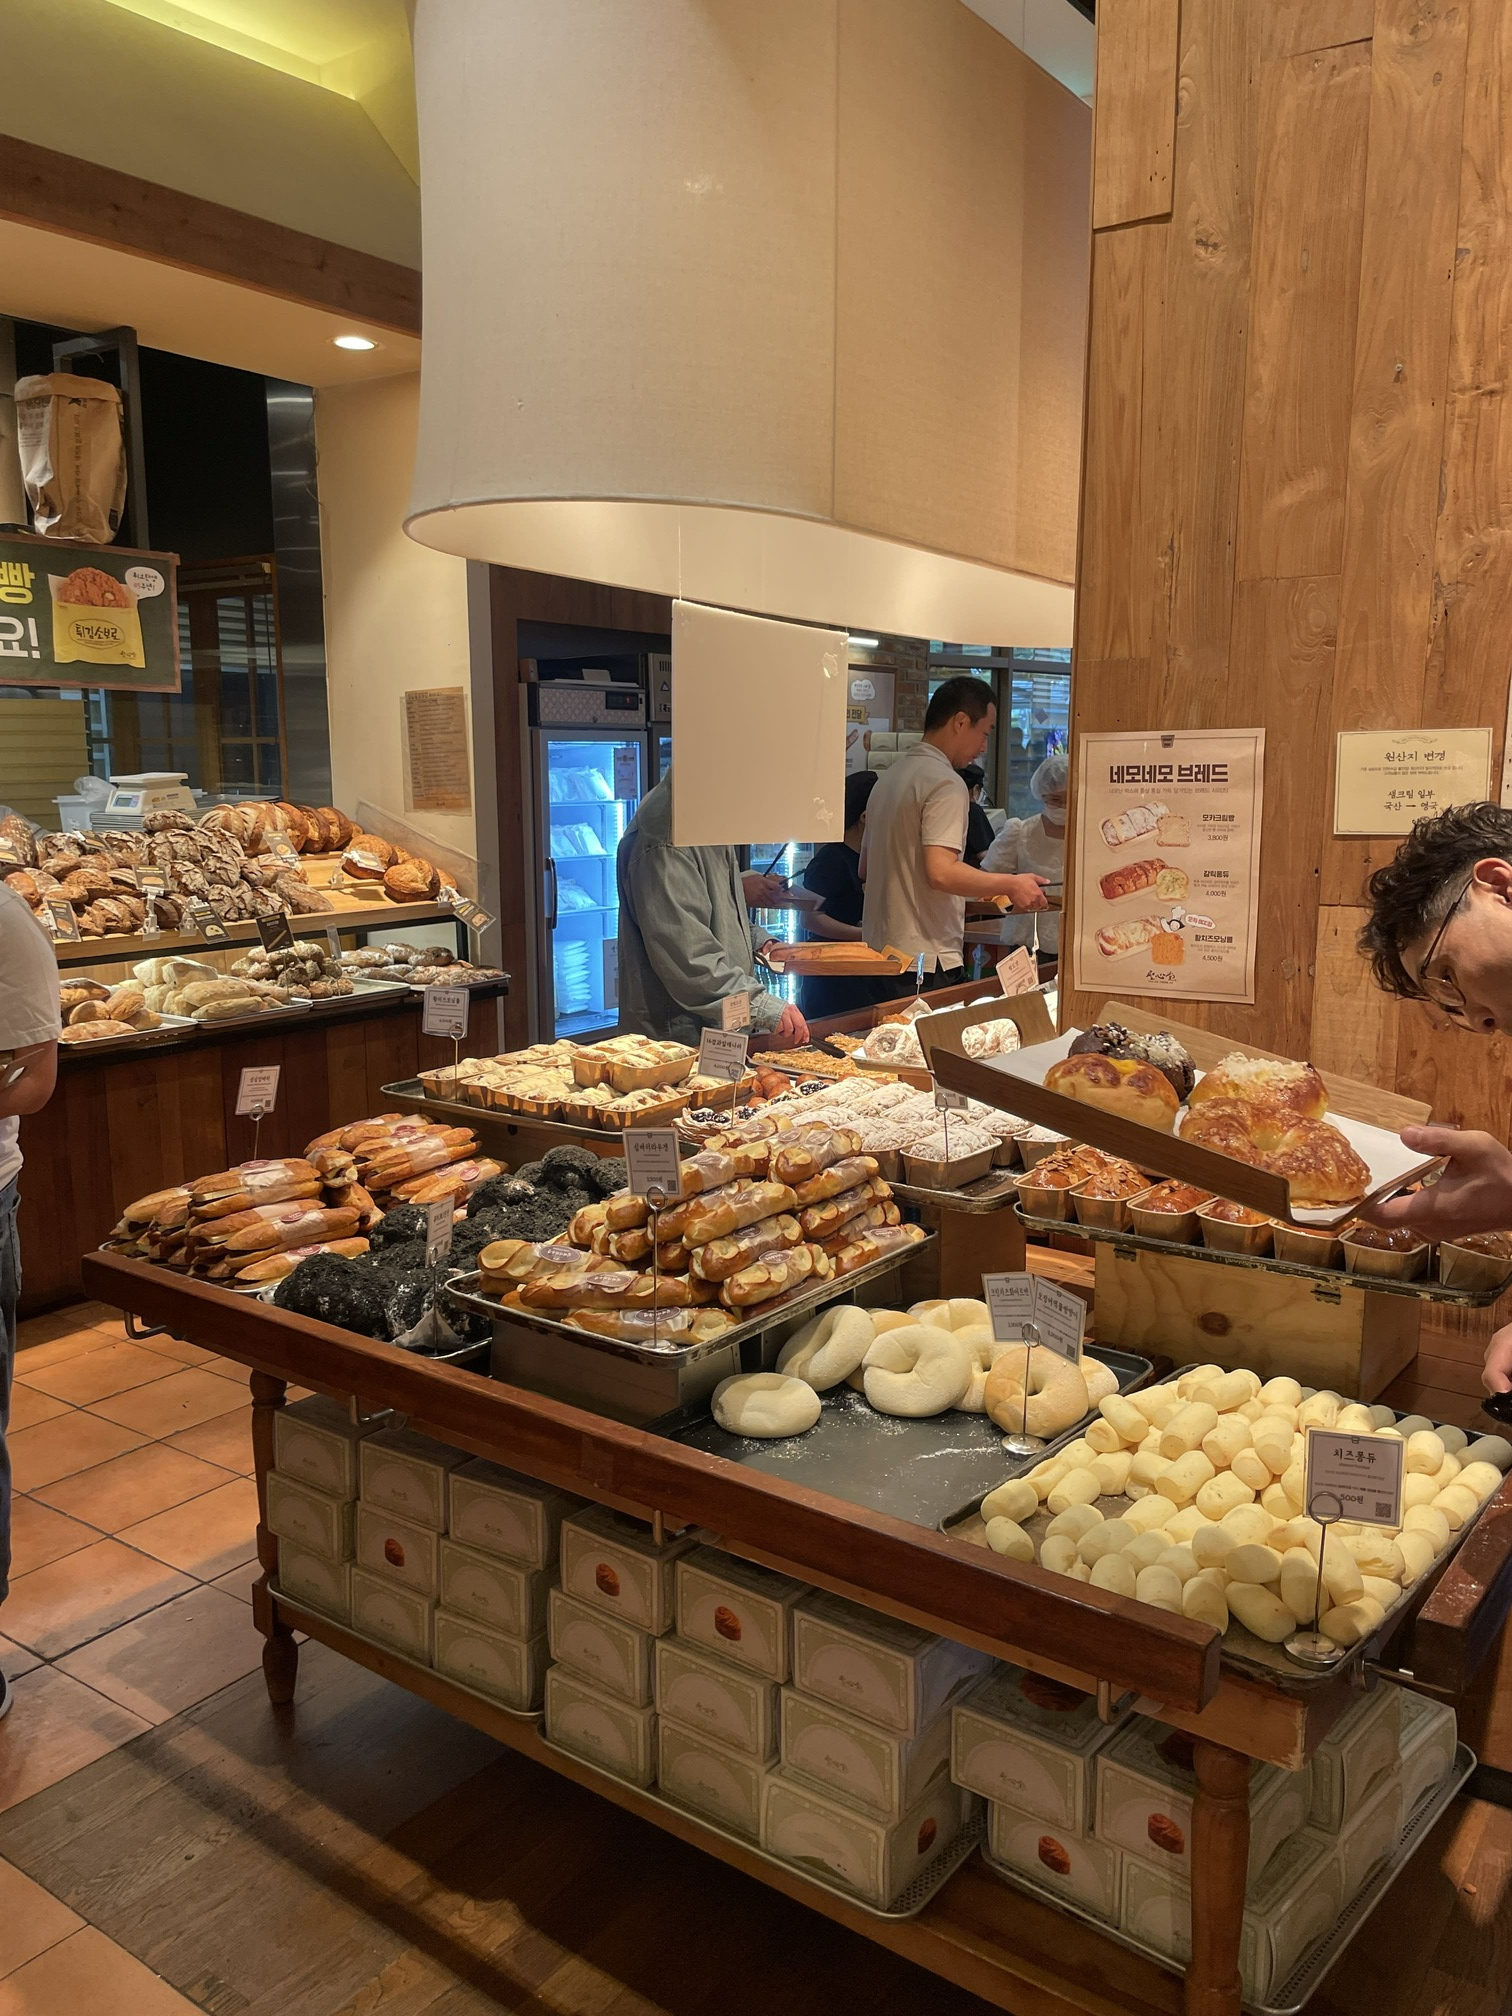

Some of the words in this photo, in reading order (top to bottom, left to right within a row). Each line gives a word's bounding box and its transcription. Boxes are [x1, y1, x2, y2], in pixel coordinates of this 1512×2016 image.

[0, 561, 36, 605] 빵
[75, 623, 120, 641] 튀김소보로
[1385, 750, 1418, 762] 원산지
[1424, 750, 1446, 762] 변경
[1109, 764, 1174, 784] 네모네모
[1177, 763, 1229, 784] 브레드
[1388, 789, 1414, 799] 생크림
[1417, 789, 1436, 799] 일부
[1384, 801, 1402, 811] 국산
[1420, 801, 1439, 811] 영국
[1207, 834, 1229, 842] 3,800원
[1205, 890, 1227, 898] 4,000원
[1202, 955, 1223, 963] 4,500원
[1333, 1447, 1377, 1464] 치즈퐁듀
